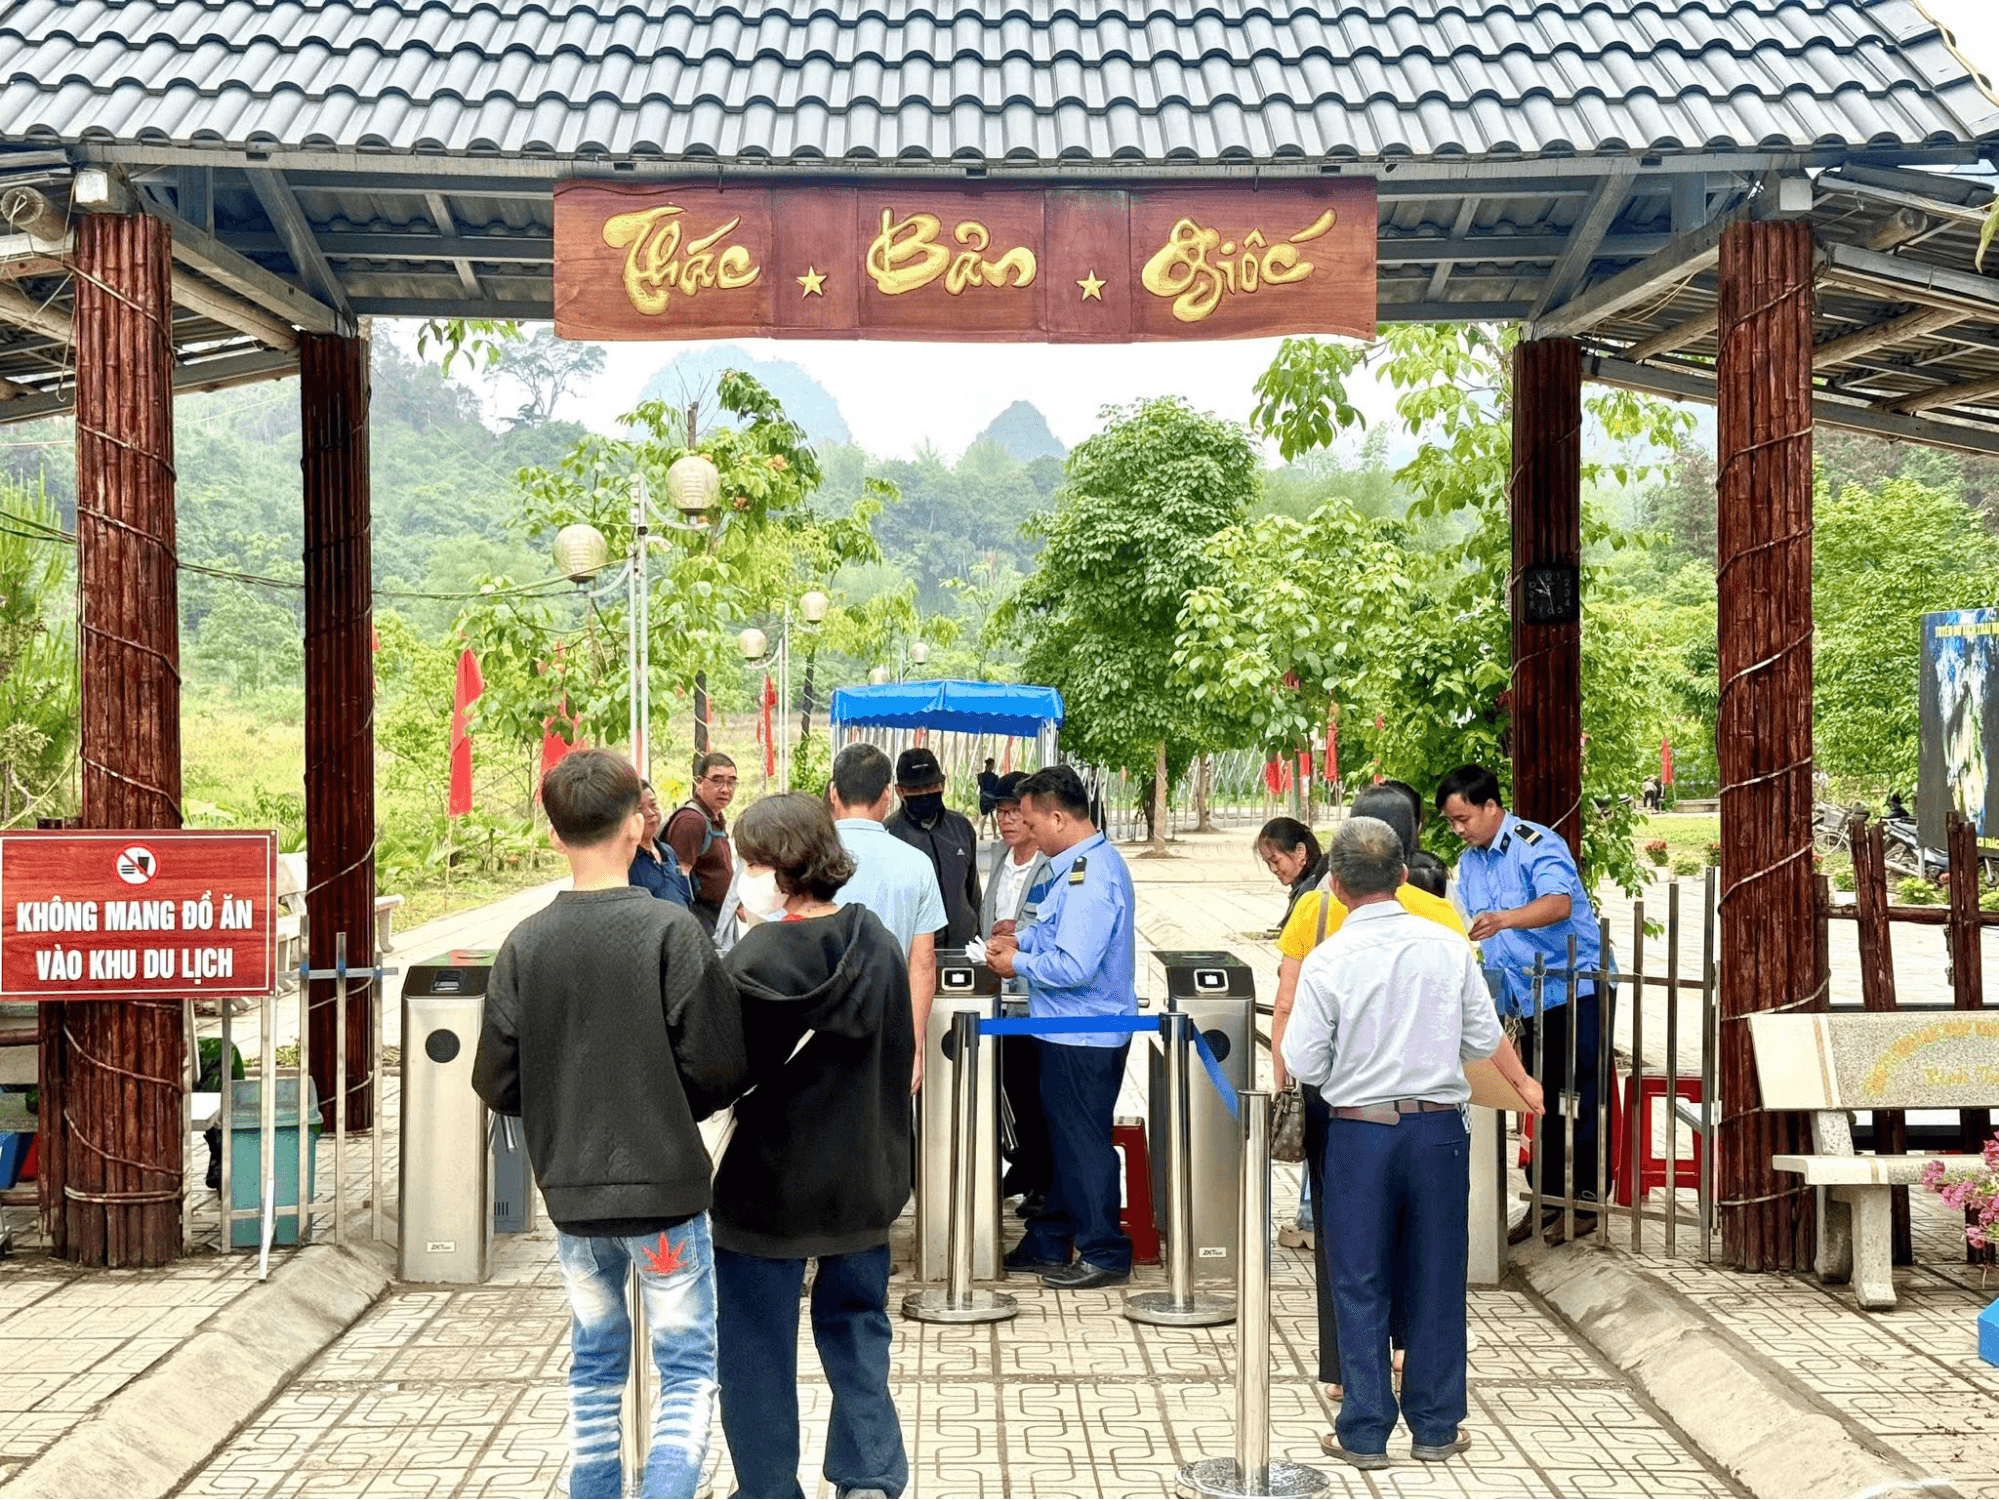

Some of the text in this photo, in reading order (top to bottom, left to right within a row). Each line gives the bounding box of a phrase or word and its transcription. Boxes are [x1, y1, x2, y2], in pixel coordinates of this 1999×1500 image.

[602, 204, 1338, 323] Thác Bản Giốc
[16, 890, 252, 932] KHÔNG MANG ĐỒ ĂN
[36, 944, 234, 985] VÀO KHU DU LỊCH
